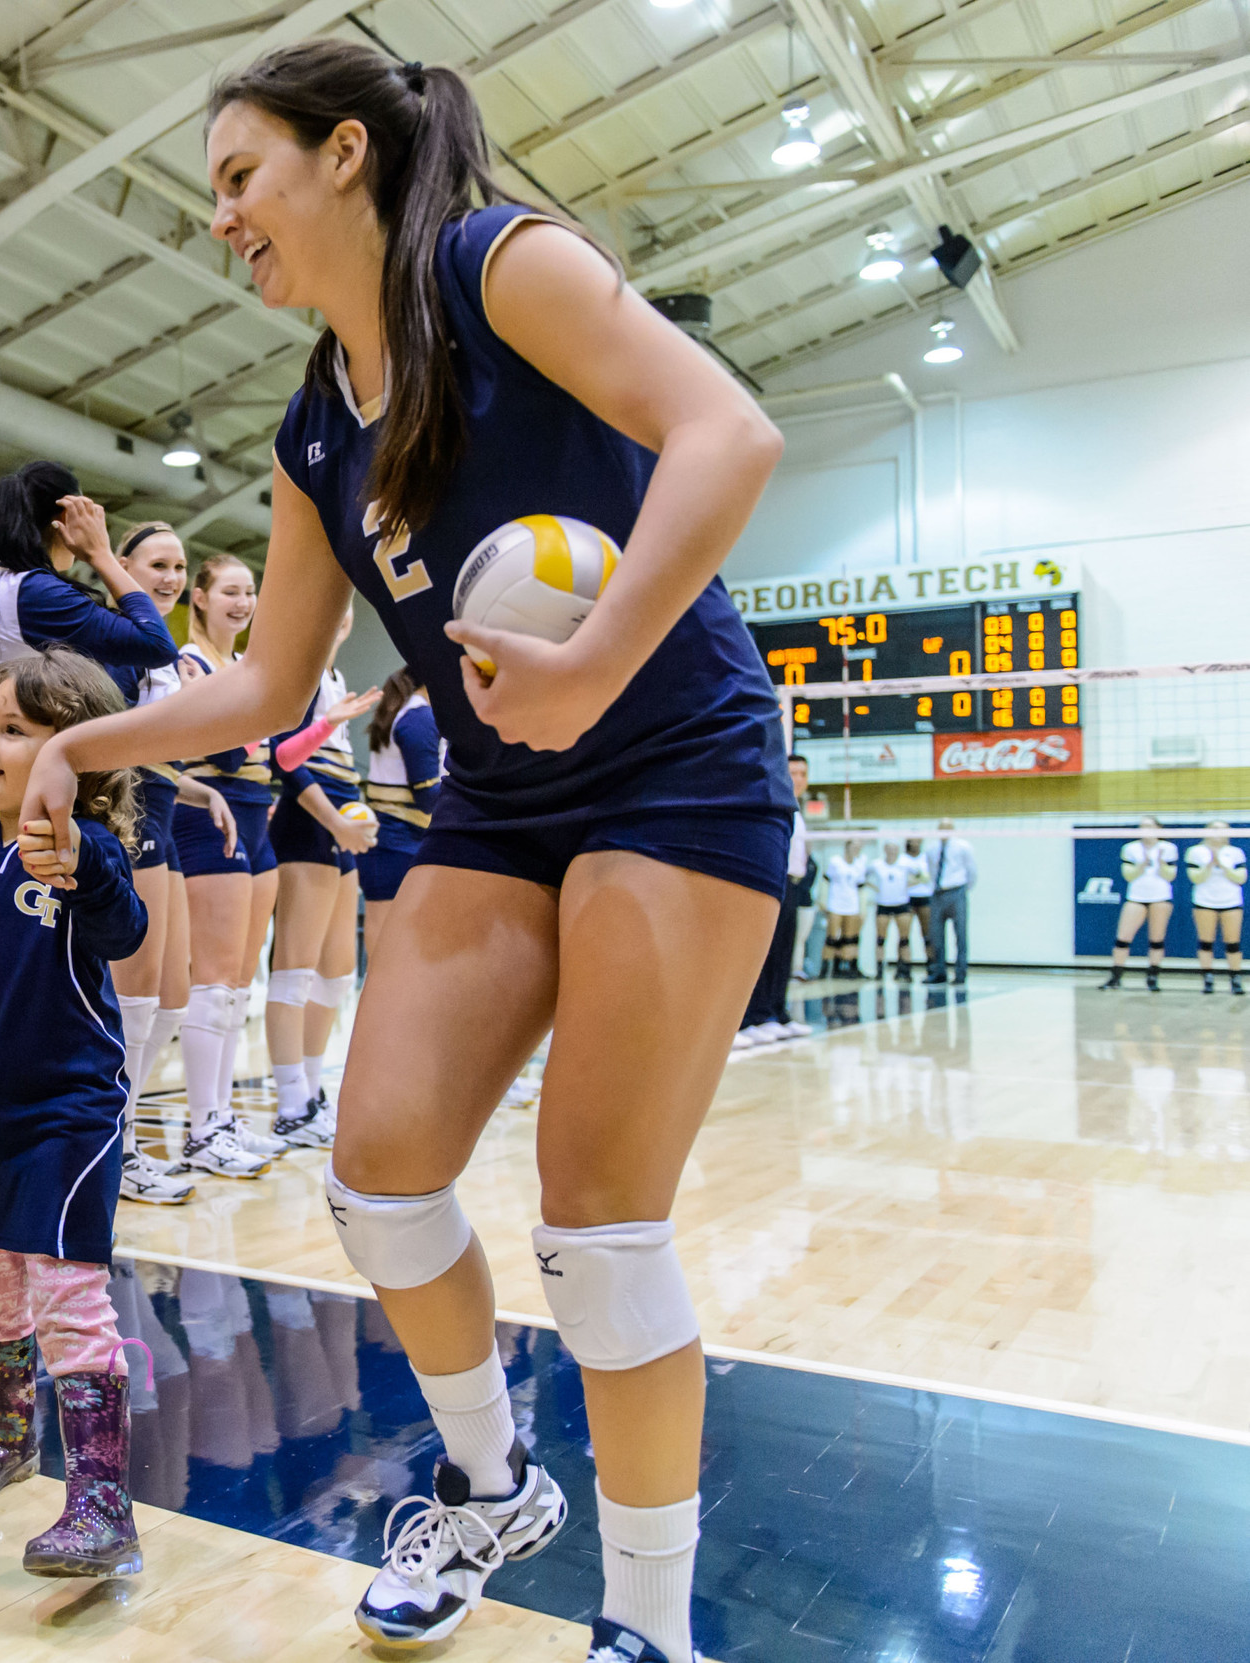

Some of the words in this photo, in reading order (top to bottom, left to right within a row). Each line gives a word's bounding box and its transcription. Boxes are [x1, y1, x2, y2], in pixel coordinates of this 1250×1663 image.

[362, 499, 433, 603] 2
[729, 575, 897, 614] GEORGIA
[908, 562, 1020, 598] TECH
[1028, 612, 1045, 632] 0
[1060, 609, 1077, 629] 0
[1028, 631, 1045, 651] 0
[1060, 629, 1077, 648] 0
[1028, 650, 1045, 669] 0
[1060, 648, 1077, 667] 0
[952, 692, 972, 718] 0
[1030, 707, 1046, 726] 0
[1062, 705, 1078, 724] 0
[14, 880, 62, 928] GT
